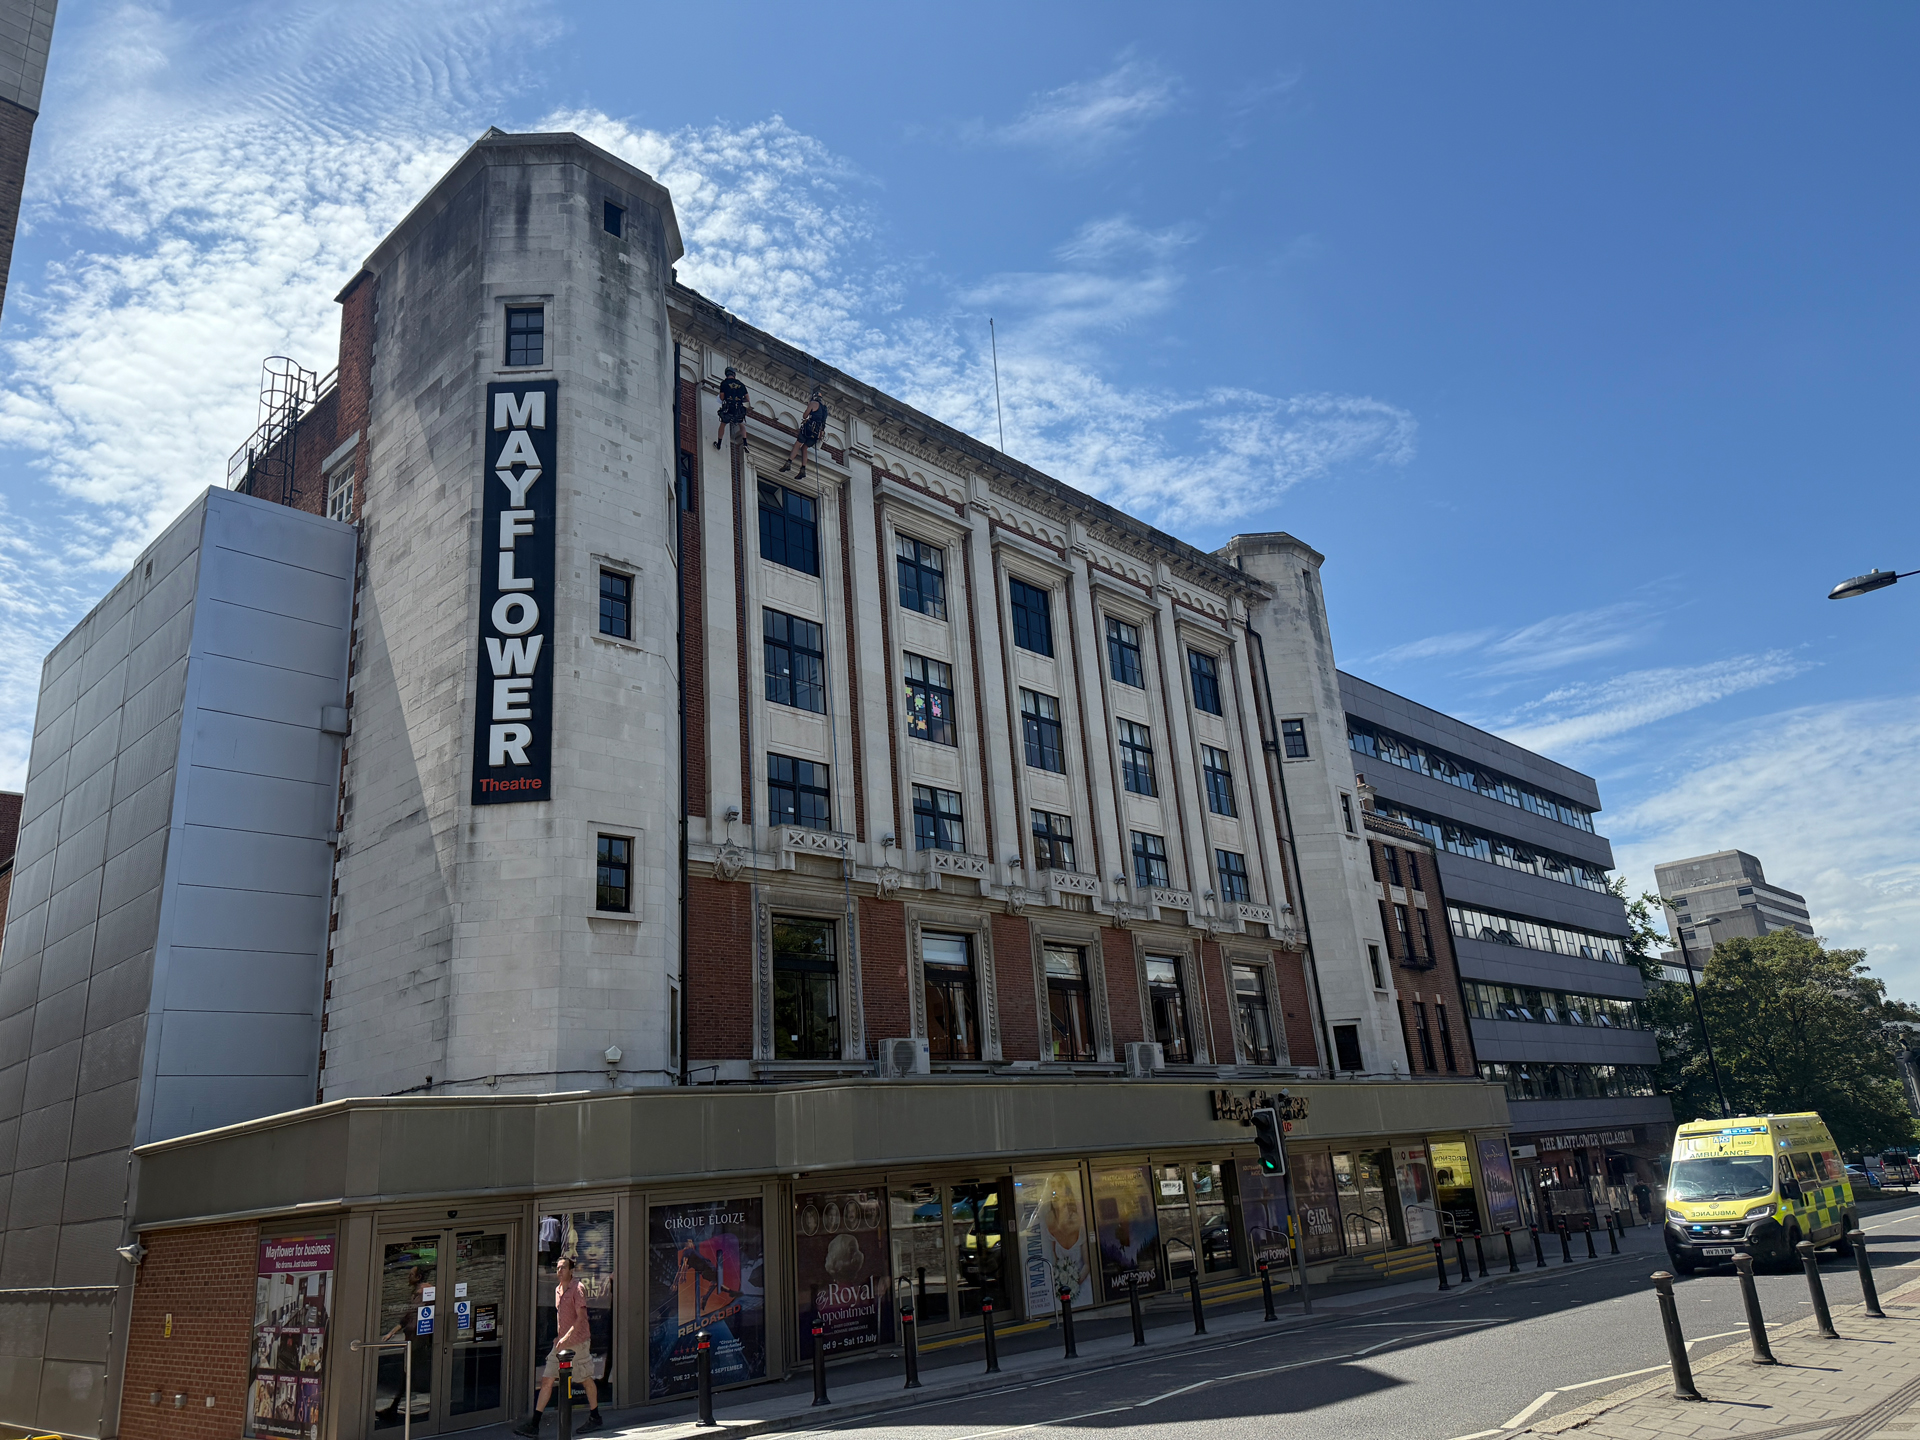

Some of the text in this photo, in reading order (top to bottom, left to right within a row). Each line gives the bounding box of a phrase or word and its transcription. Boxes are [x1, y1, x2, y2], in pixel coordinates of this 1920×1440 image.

[484, 391, 546, 766] MAYFLOWER
[480, 777, 542, 792] Theatre
[1540, 1130, 1628, 1151] THE MAYFLOWER VILLAGE
[1690, 1150, 1750, 1158] AMBULANCE
[665, 1216, 705, 1230] CIRQUE
[1314, 1224, 1333, 1235] TRAIN
[266, 1243, 331, 1260] Mayflower for business
[1027, 1223, 1046, 1288] MAMMA
[1111, 1272, 1129, 1288] MARY
[816, 1275, 874, 1310] By Royal
[678, 1304, 742, 1338] RELOADED
[818, 1304, 875, 1325] Appointment
[844, 1338, 855, 1346] Sat
[857, 1335, 864, 1344] 12
[865, 1333, 877, 1342] July
[715, 1364, 743, 1373] SEPTEMBER
